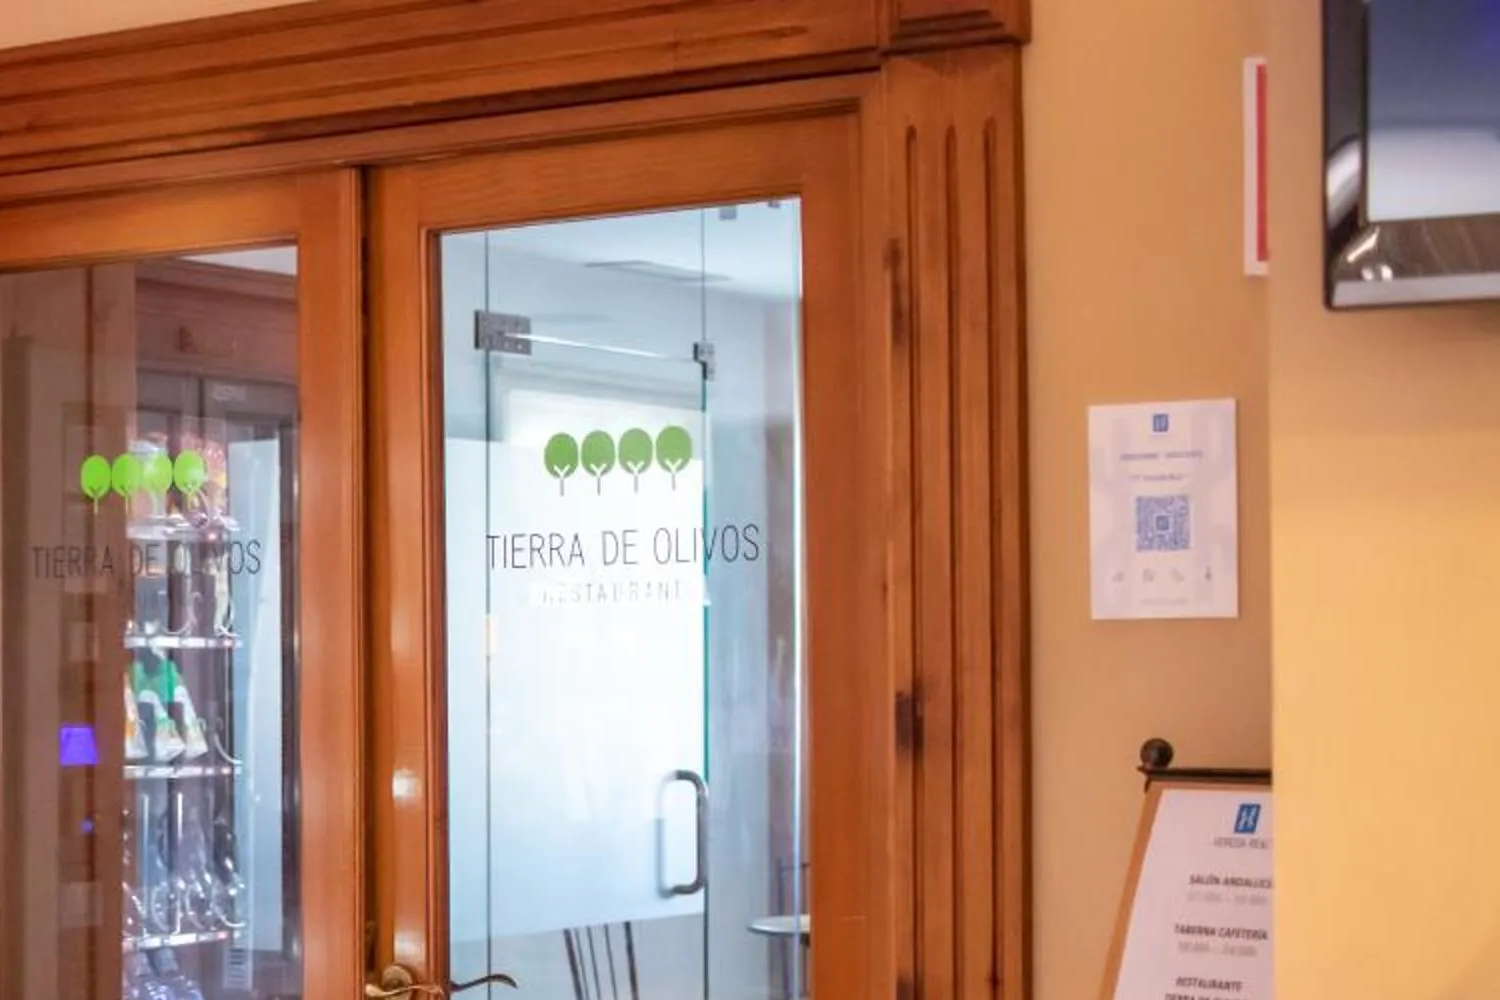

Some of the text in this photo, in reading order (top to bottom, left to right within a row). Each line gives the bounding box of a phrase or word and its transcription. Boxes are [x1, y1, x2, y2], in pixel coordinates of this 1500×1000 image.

[33, 544, 114, 579] TIERRA
[129, 543, 159, 577] DE
[486, 523, 760, 569] TIERRA DE OLIVOS
[1175, 976, 1243, 992] RESTAURANTE
